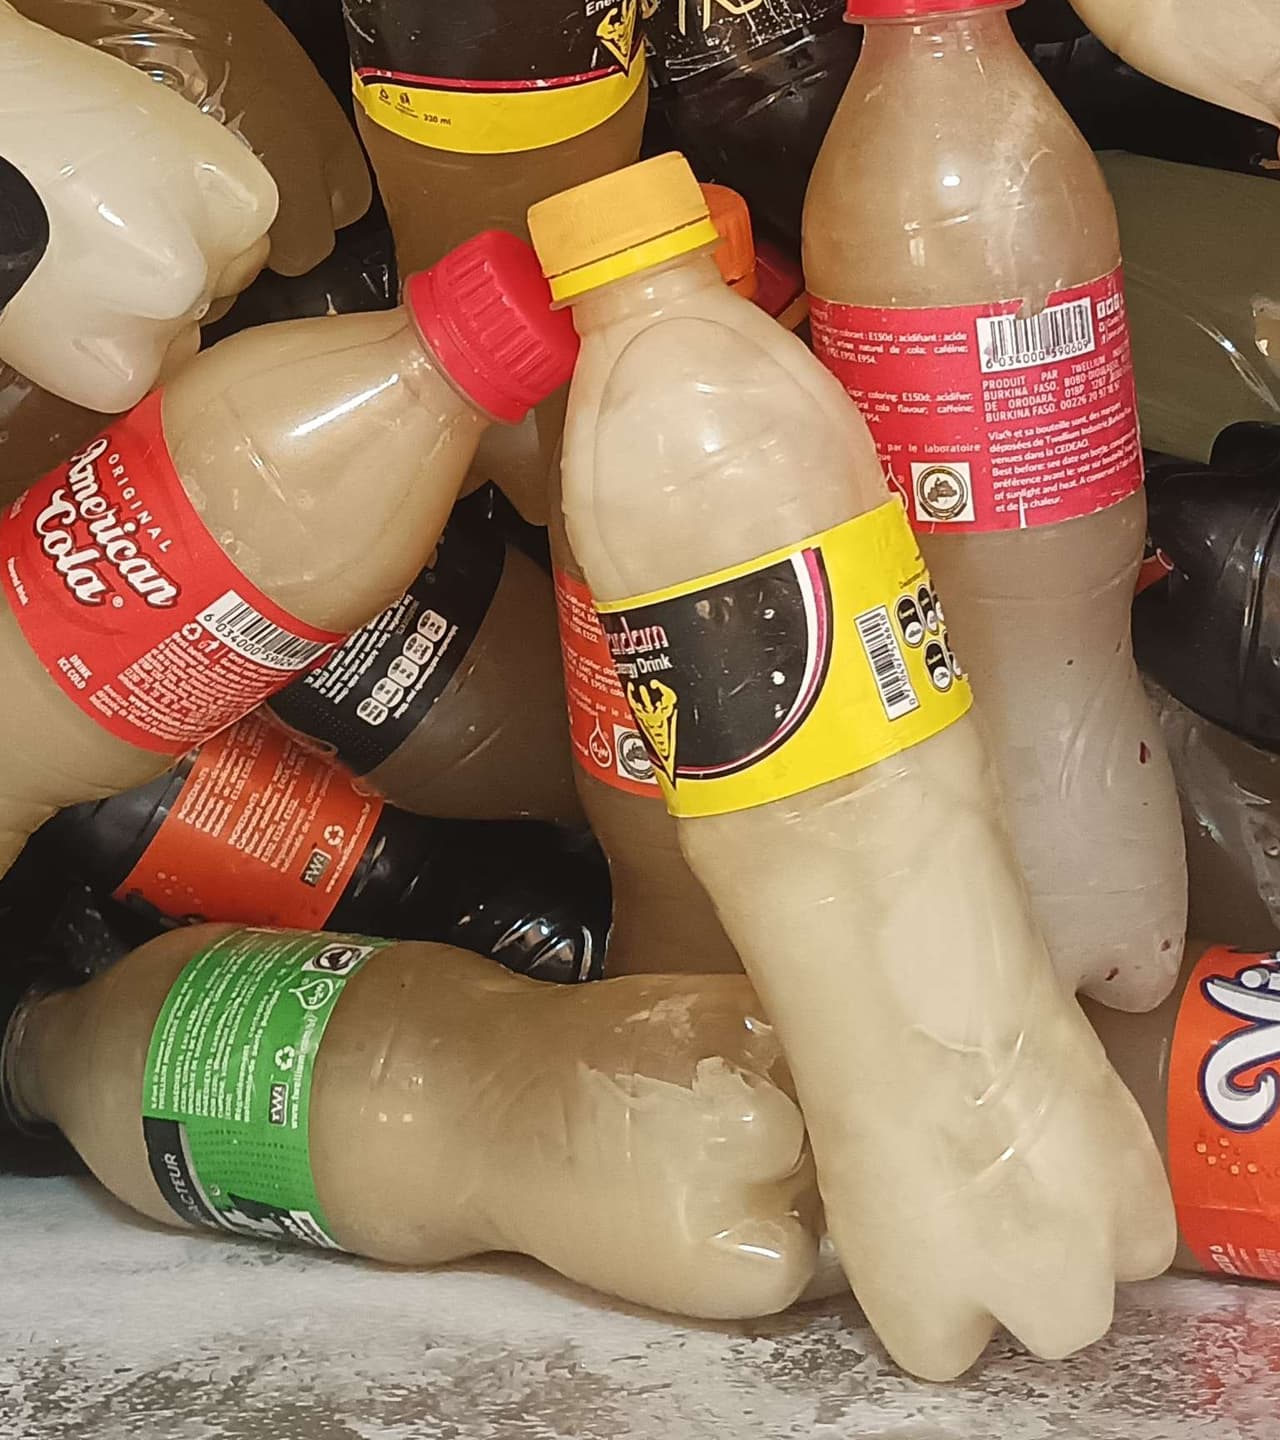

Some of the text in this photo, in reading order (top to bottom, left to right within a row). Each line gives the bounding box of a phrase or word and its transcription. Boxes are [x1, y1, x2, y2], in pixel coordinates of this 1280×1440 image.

[99, 452, 179, 554] ORIGINAL
[66, 437, 178, 610] American
[41, 489, 111, 608] Cola
[213, 620, 261, 658] 034000
[65, 667, 87, 691] COLD
[68, 653, 92, 681] DRINK
[636, 651, 672, 675] Drink
